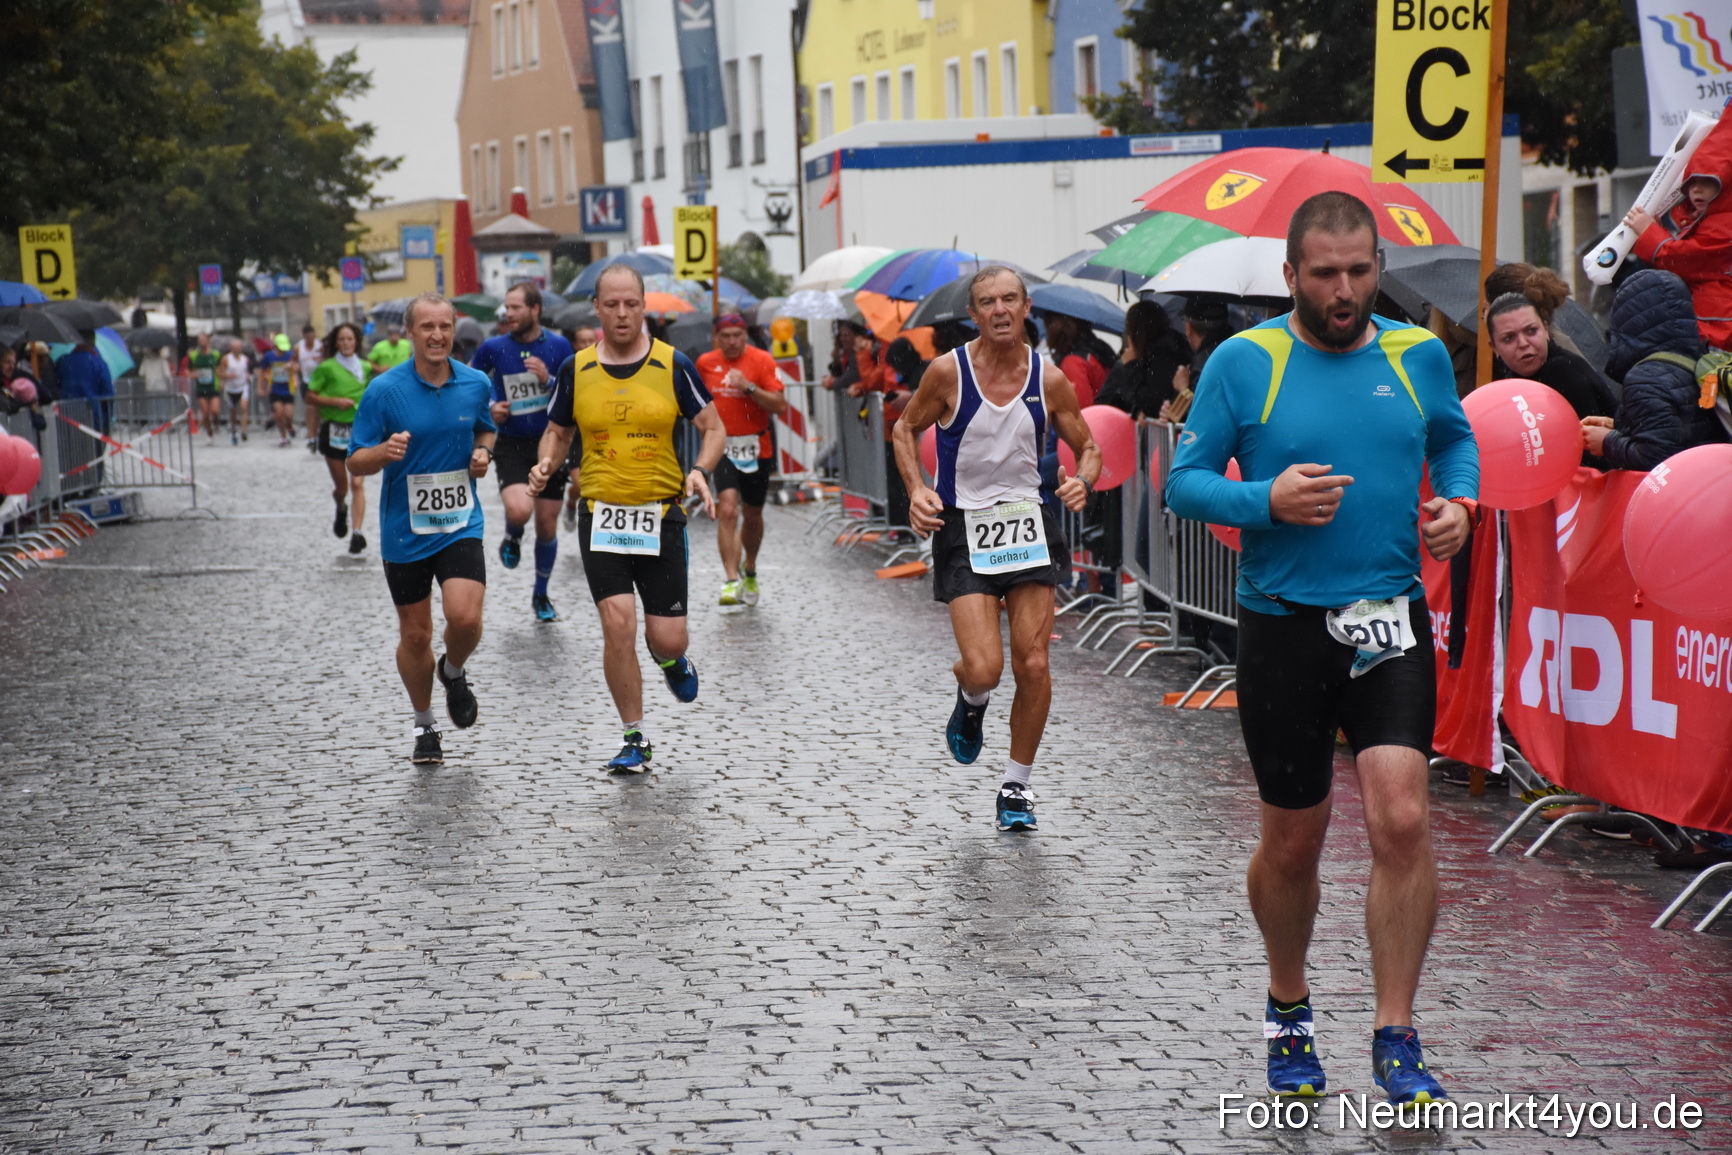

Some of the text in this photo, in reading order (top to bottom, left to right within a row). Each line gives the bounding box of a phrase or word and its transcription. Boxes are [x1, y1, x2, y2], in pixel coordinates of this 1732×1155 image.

[1392, 0, 1491, 31] Block
[1406, 46, 1471, 142] C
[678, 208, 712, 222] Block
[26, 228, 65, 244] Block
[686, 229, 706, 263] D
[35, 249, 61, 284] D
[416, 484, 468, 512] 2858
[429, 516, 460, 526] Markus
[600, 507, 656, 534] 2815
[975, 517, 1038, 550] 2273
[607, 535, 645, 547] Joachim
[989, 549, 1030, 565] Gerhard
